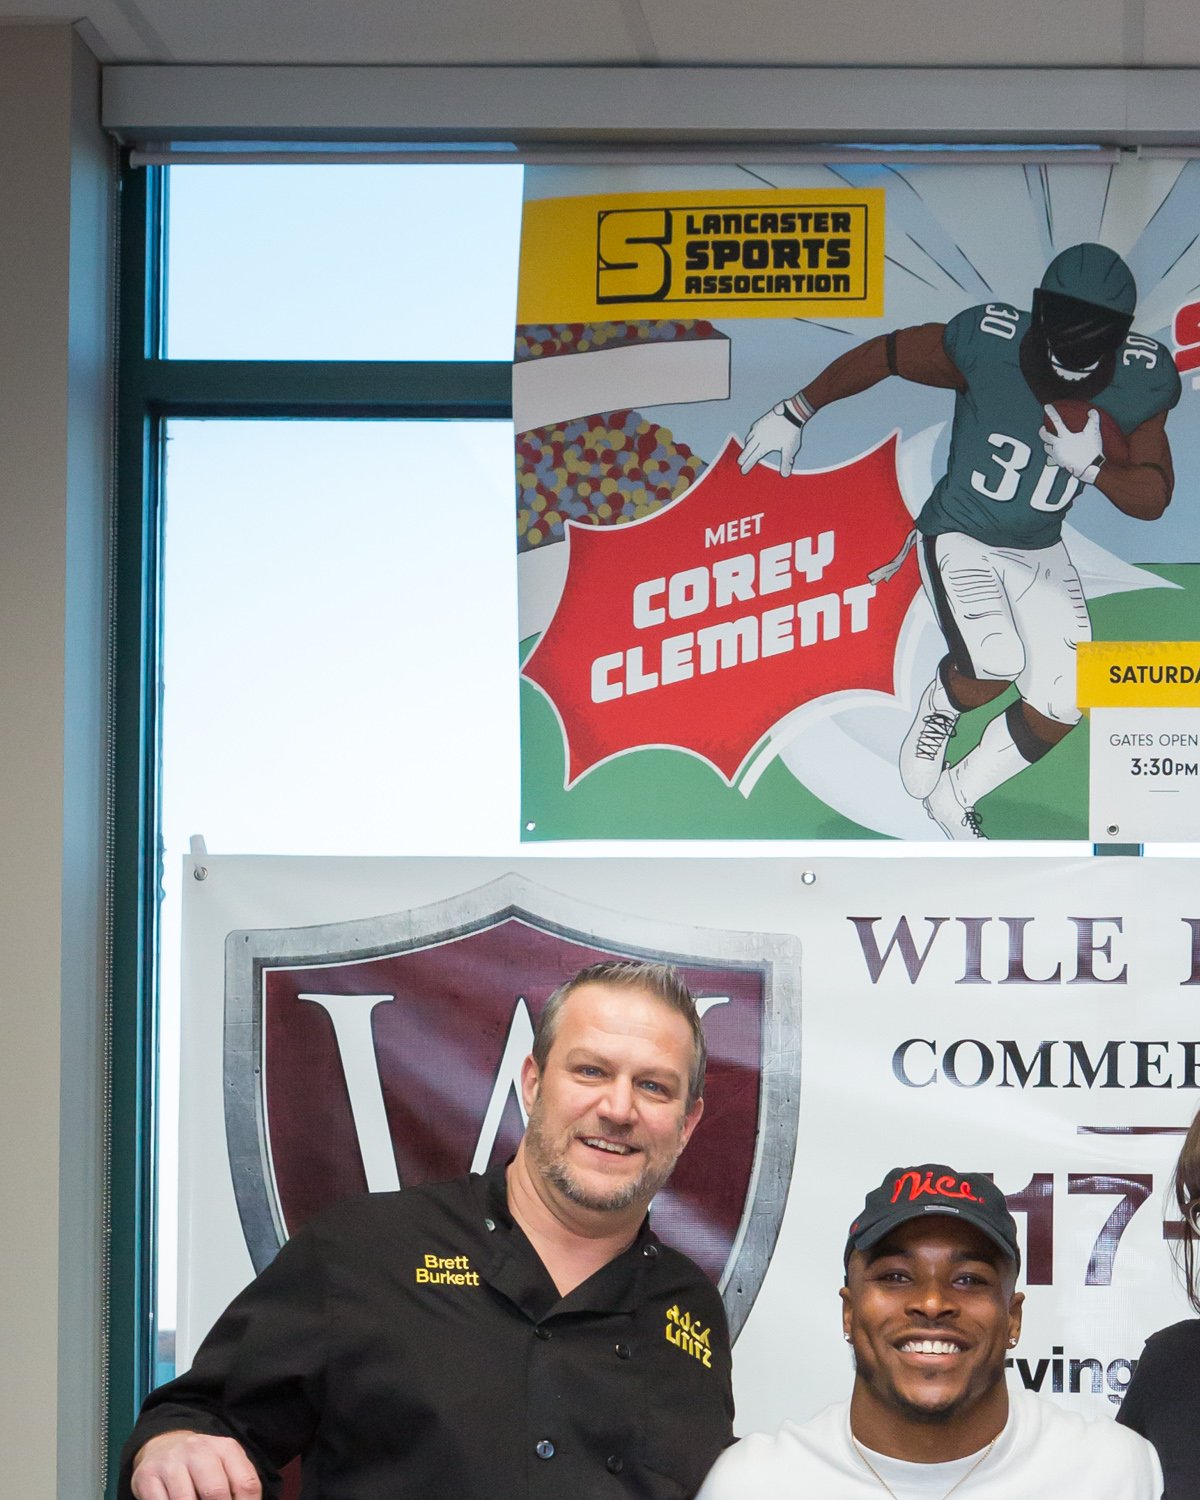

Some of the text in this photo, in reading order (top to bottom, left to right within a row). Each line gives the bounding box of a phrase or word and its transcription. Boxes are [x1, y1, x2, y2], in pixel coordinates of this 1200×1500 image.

[685, 212, 852, 235] LANCASTER
[685, 239, 852, 270] SPORTS
[685, 274, 851, 294] ASSOCIATION
[970, 433, 1080, 512] 30
[704, 513, 765, 548] MEET
[632, 530, 836, 630] COREY
[590, 582, 878, 704] CLEMENT
[1109, 734, 1154, 747] GATES
[1159, 734, 1199, 747] OPEN
[1130, 757, 1199, 777] 3:30PM
[846, 915, 1128, 985] WILE
[424, 1254, 469, 1270] Brett
[416, 1268, 480, 1286] Burkett
